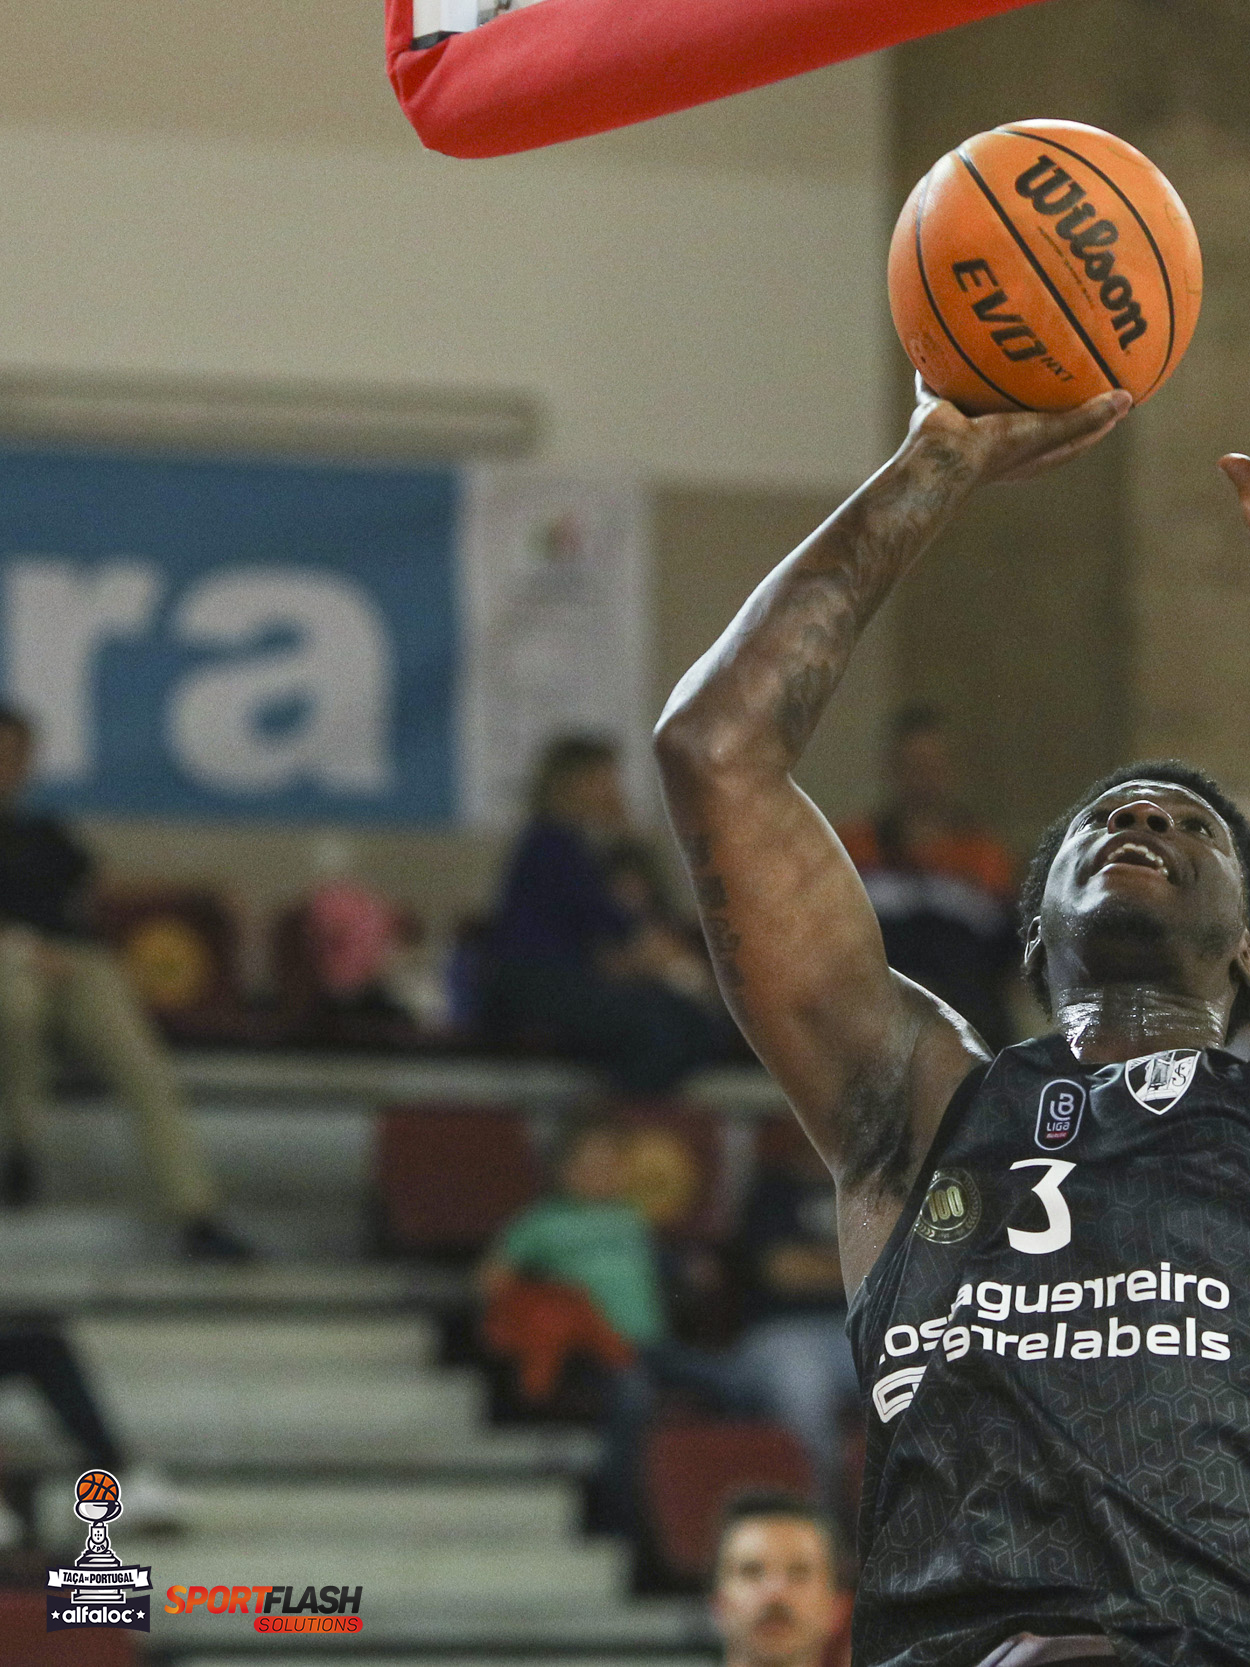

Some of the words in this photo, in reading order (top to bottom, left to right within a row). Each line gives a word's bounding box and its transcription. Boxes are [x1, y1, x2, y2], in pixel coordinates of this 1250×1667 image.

[1014, 154, 1147, 351] Wilson
[952, 257, 1047, 362] EVO
[1007, 1158, 1077, 1255] 3
